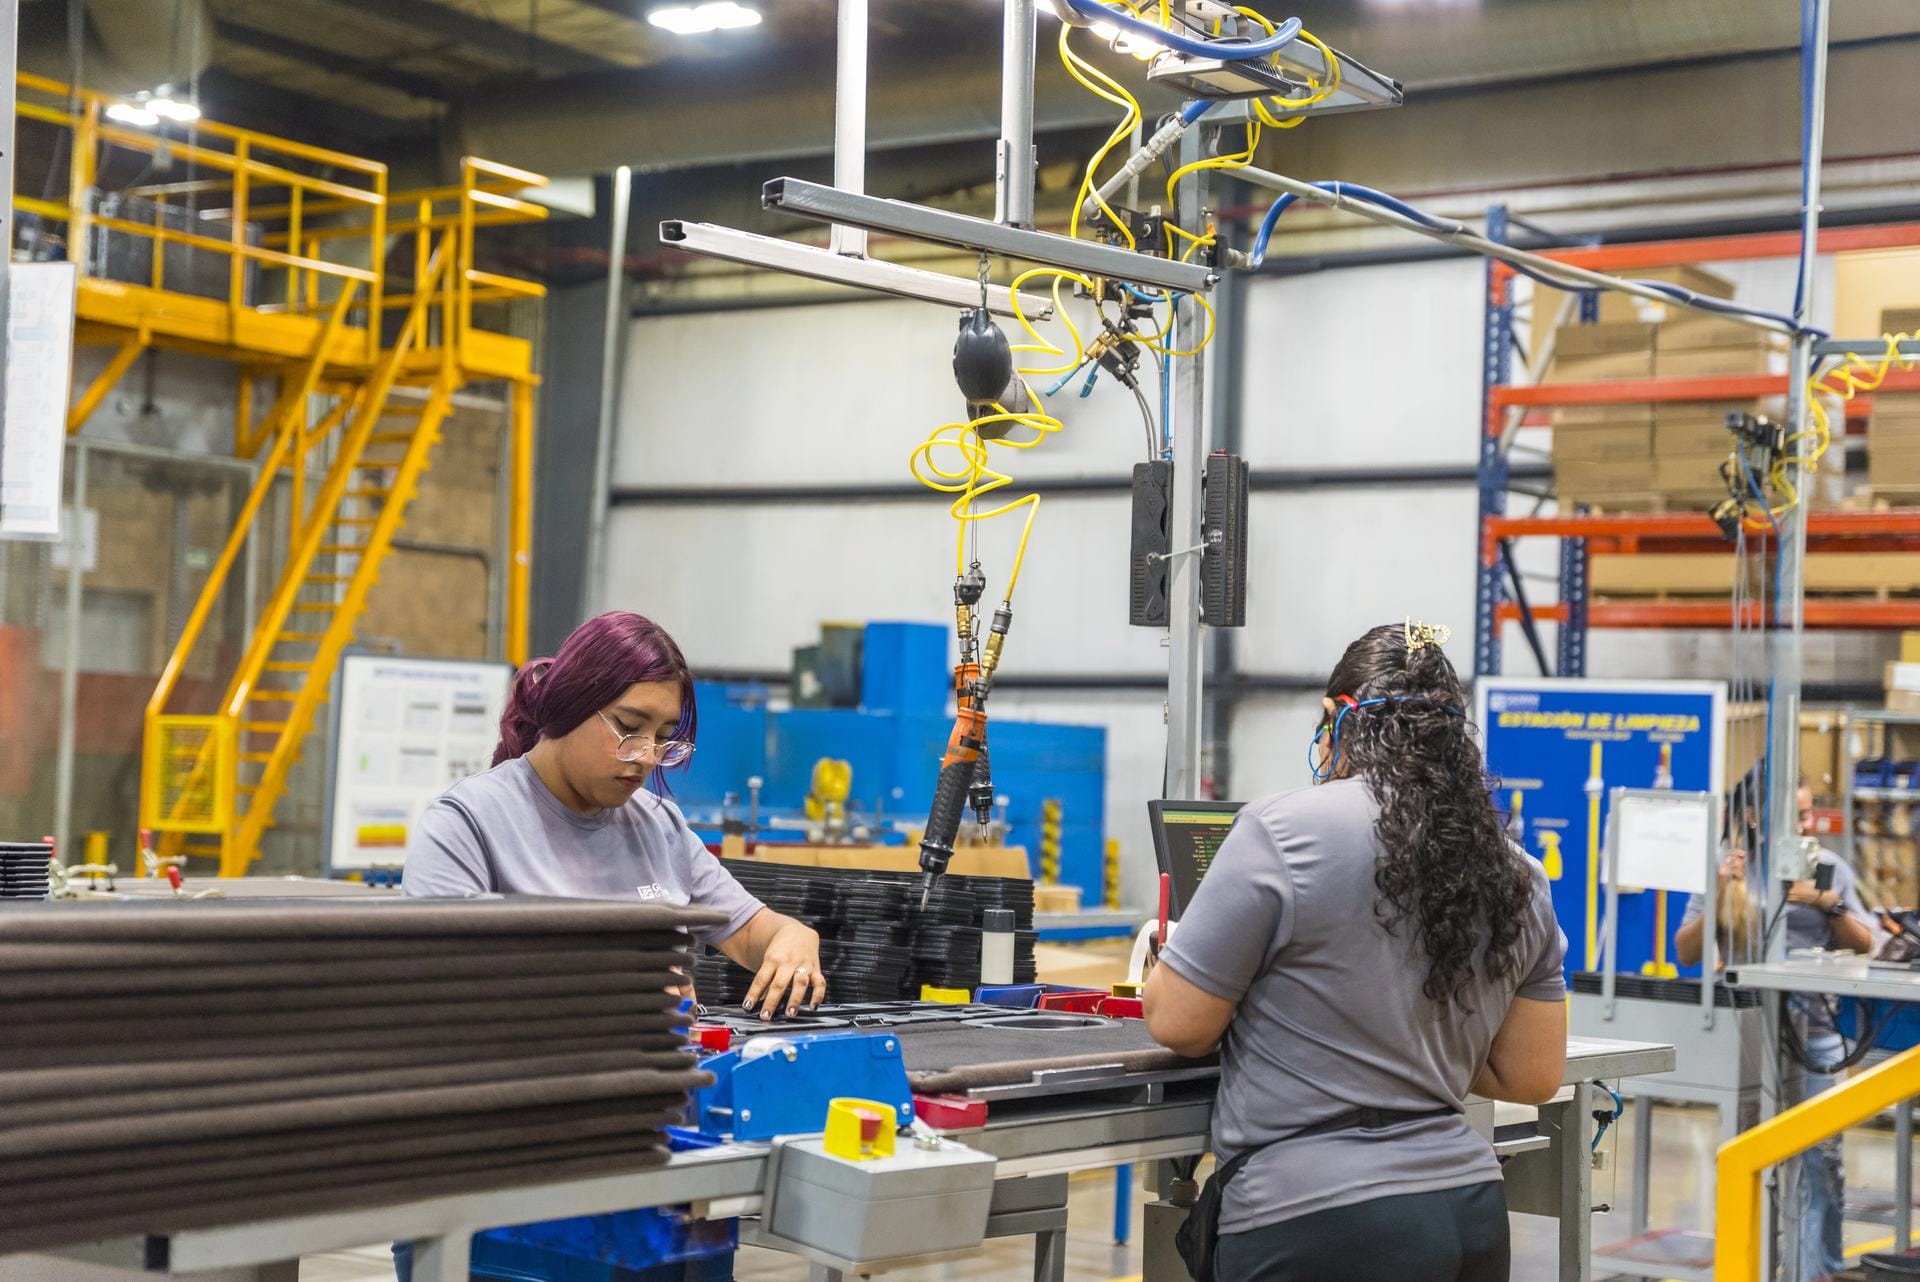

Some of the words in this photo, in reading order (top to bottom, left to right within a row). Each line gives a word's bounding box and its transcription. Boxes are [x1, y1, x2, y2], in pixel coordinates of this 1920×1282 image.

[1498, 710, 1584, 728] ESTACIÓN
[1586, 713, 1611, 730] DE
[1614, 714, 1700, 731] LIMPIEZA
